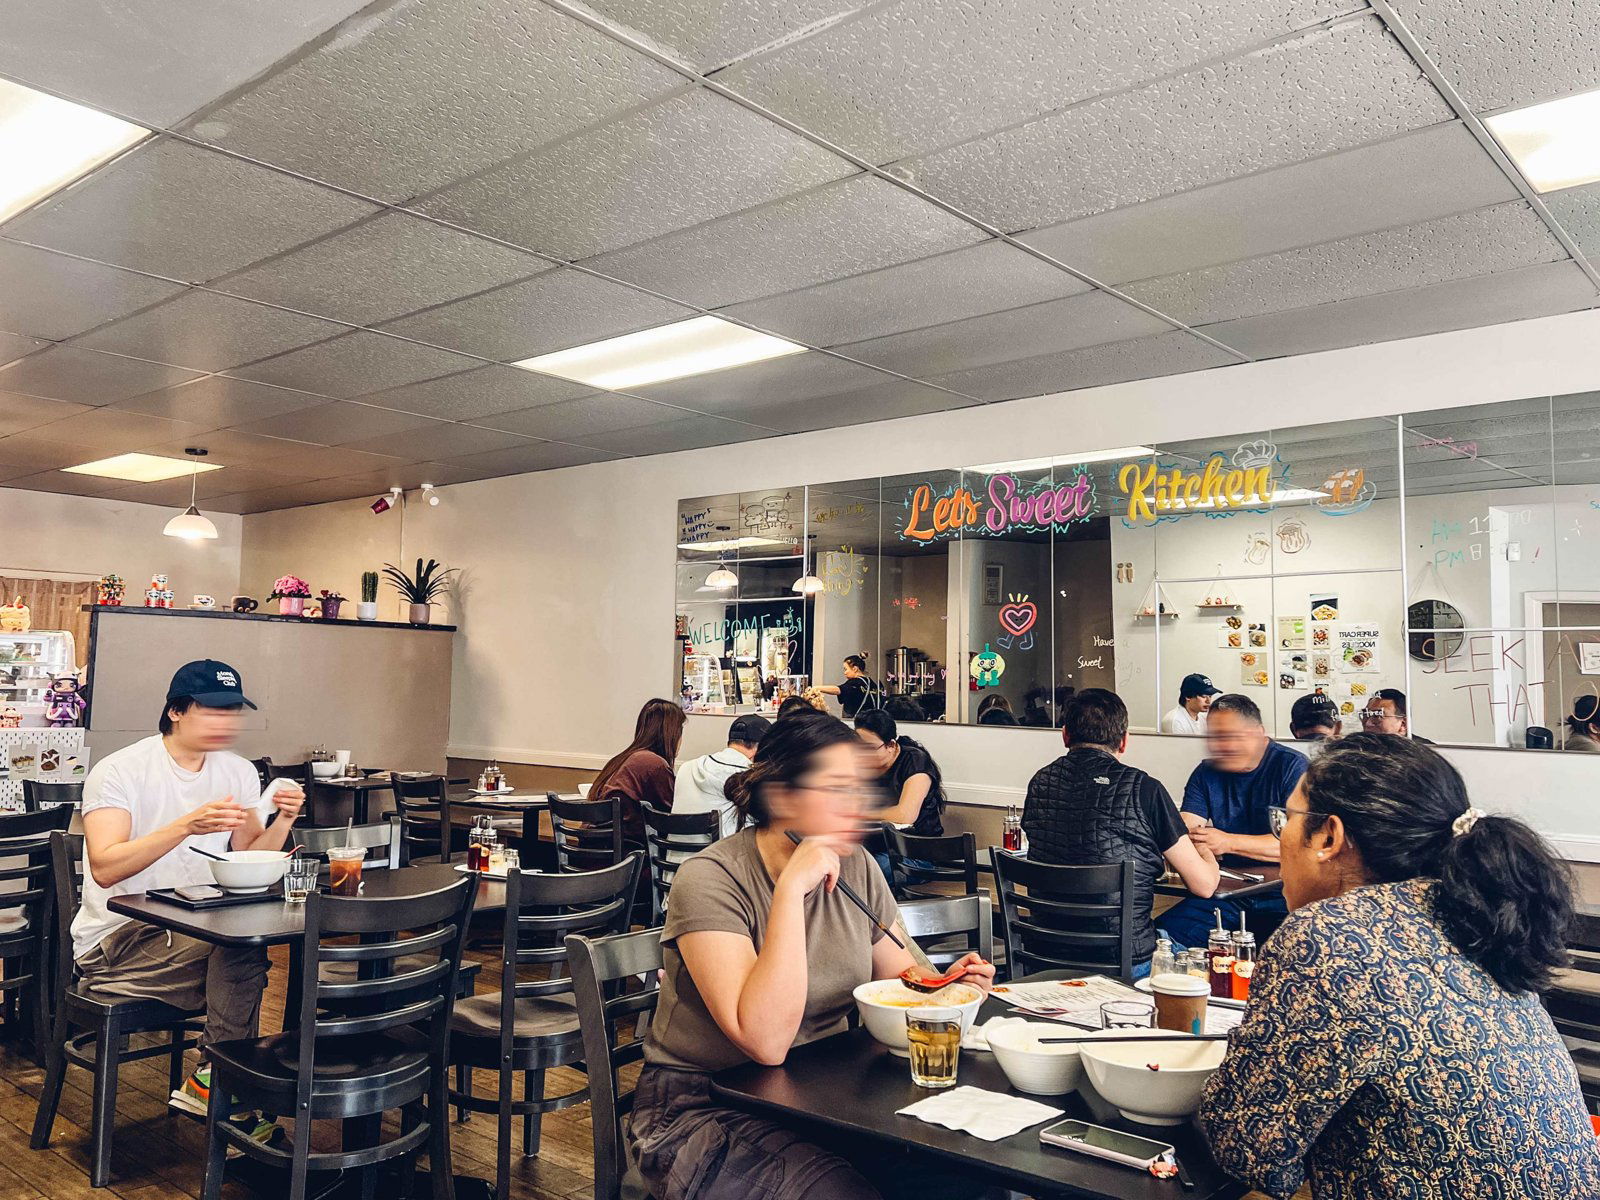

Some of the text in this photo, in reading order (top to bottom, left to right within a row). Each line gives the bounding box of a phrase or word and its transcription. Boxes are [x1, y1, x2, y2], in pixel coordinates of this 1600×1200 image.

[985, 474, 1091, 531] Sweet
[1118, 456, 1277, 521] Kitchen
[688, 613, 771, 646] WELCOME
[1093, 635, 1115, 647] Have
[1077, 655, 1104, 669] Sweet
[1422, 635, 1525, 674] SEEK
